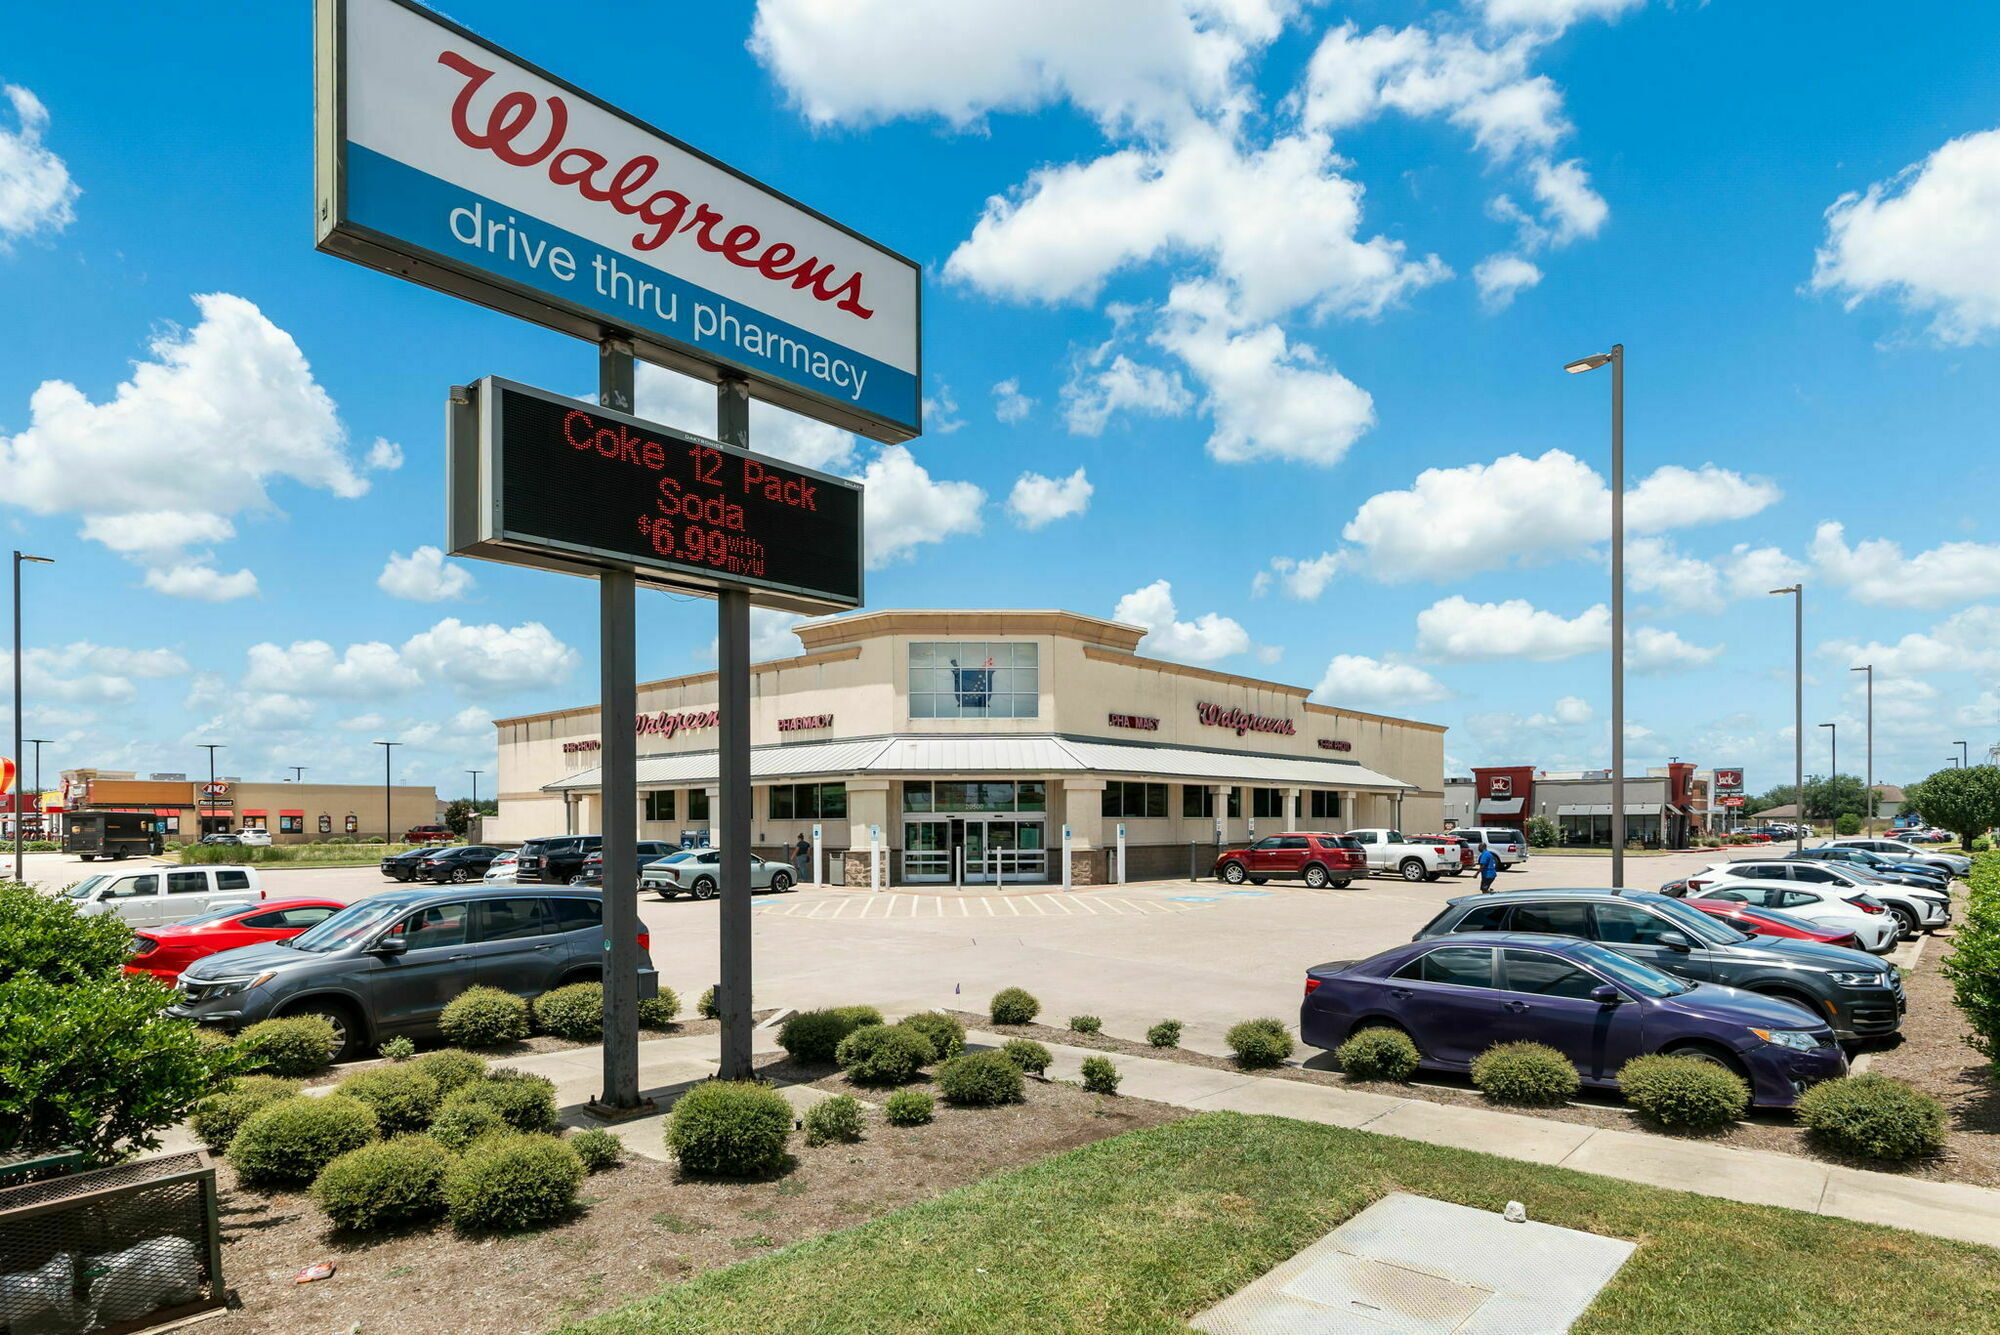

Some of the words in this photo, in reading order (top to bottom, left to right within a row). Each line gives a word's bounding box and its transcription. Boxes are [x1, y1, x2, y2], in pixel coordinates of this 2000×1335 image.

[438, 50, 874, 320] Walgreens
[449, 202, 576, 282] drive
[592, 254, 677, 322] thru
[693, 302, 868, 401] pharmacy
[684, 434, 724, 450] DAKTRONICS
[564, 409, 665, 470] Coke
[688, 444, 722, 487] 12
[743, 458, 817, 511] Pack
[657, 476, 746, 532] Soda
[638, 514, 728, 566] $6.99
[727, 535, 764, 558] with
[777, 713, 834, 731] PHARMACY
[1197, 702, 1297, 736] Walgreens
[207, 784, 228, 796] DQ
[1491, 778, 1510, 790] Jack
[1717, 771, 1741, 786] Jack
